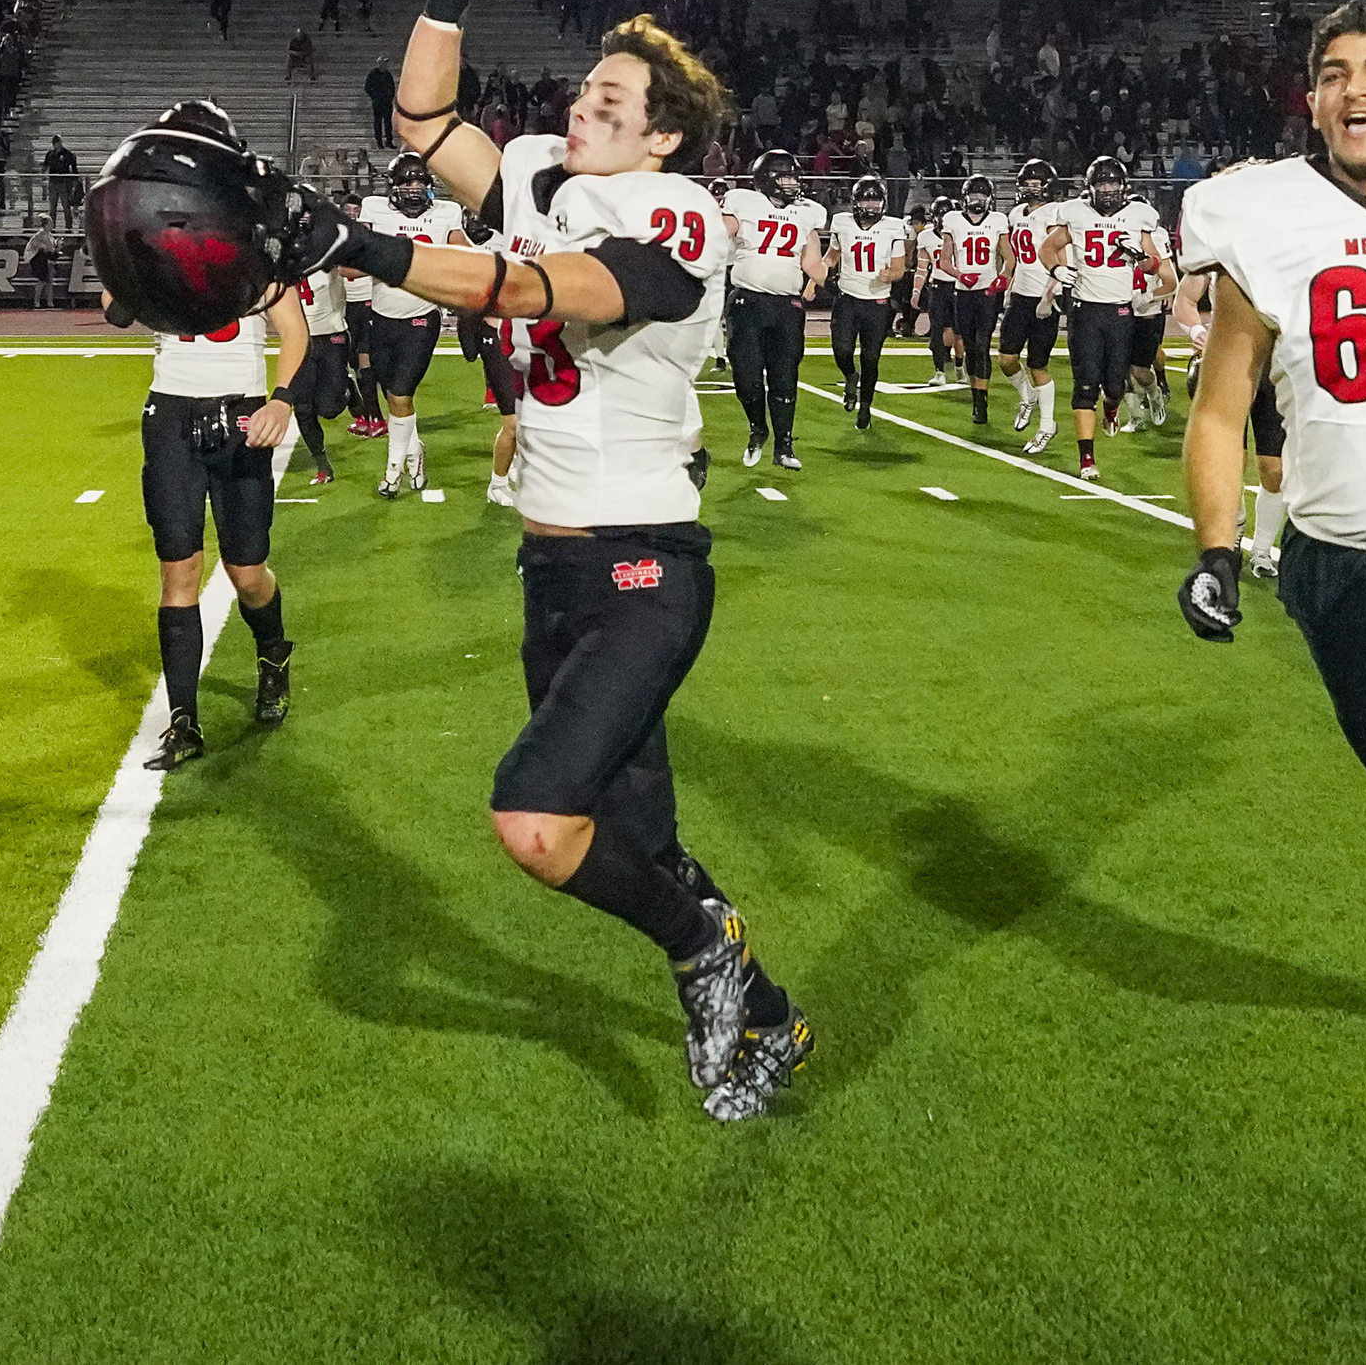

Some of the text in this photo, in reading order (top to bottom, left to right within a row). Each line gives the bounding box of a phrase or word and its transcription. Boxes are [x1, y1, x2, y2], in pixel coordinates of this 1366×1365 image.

[651, 207, 705, 262] 23
[757, 219, 799, 258] 72
[962, 237, 990, 266] 16
[1012, 229, 1037, 264] 19
[1084, 229, 1127, 268] 52
[850, 241, 876, 273] 11
